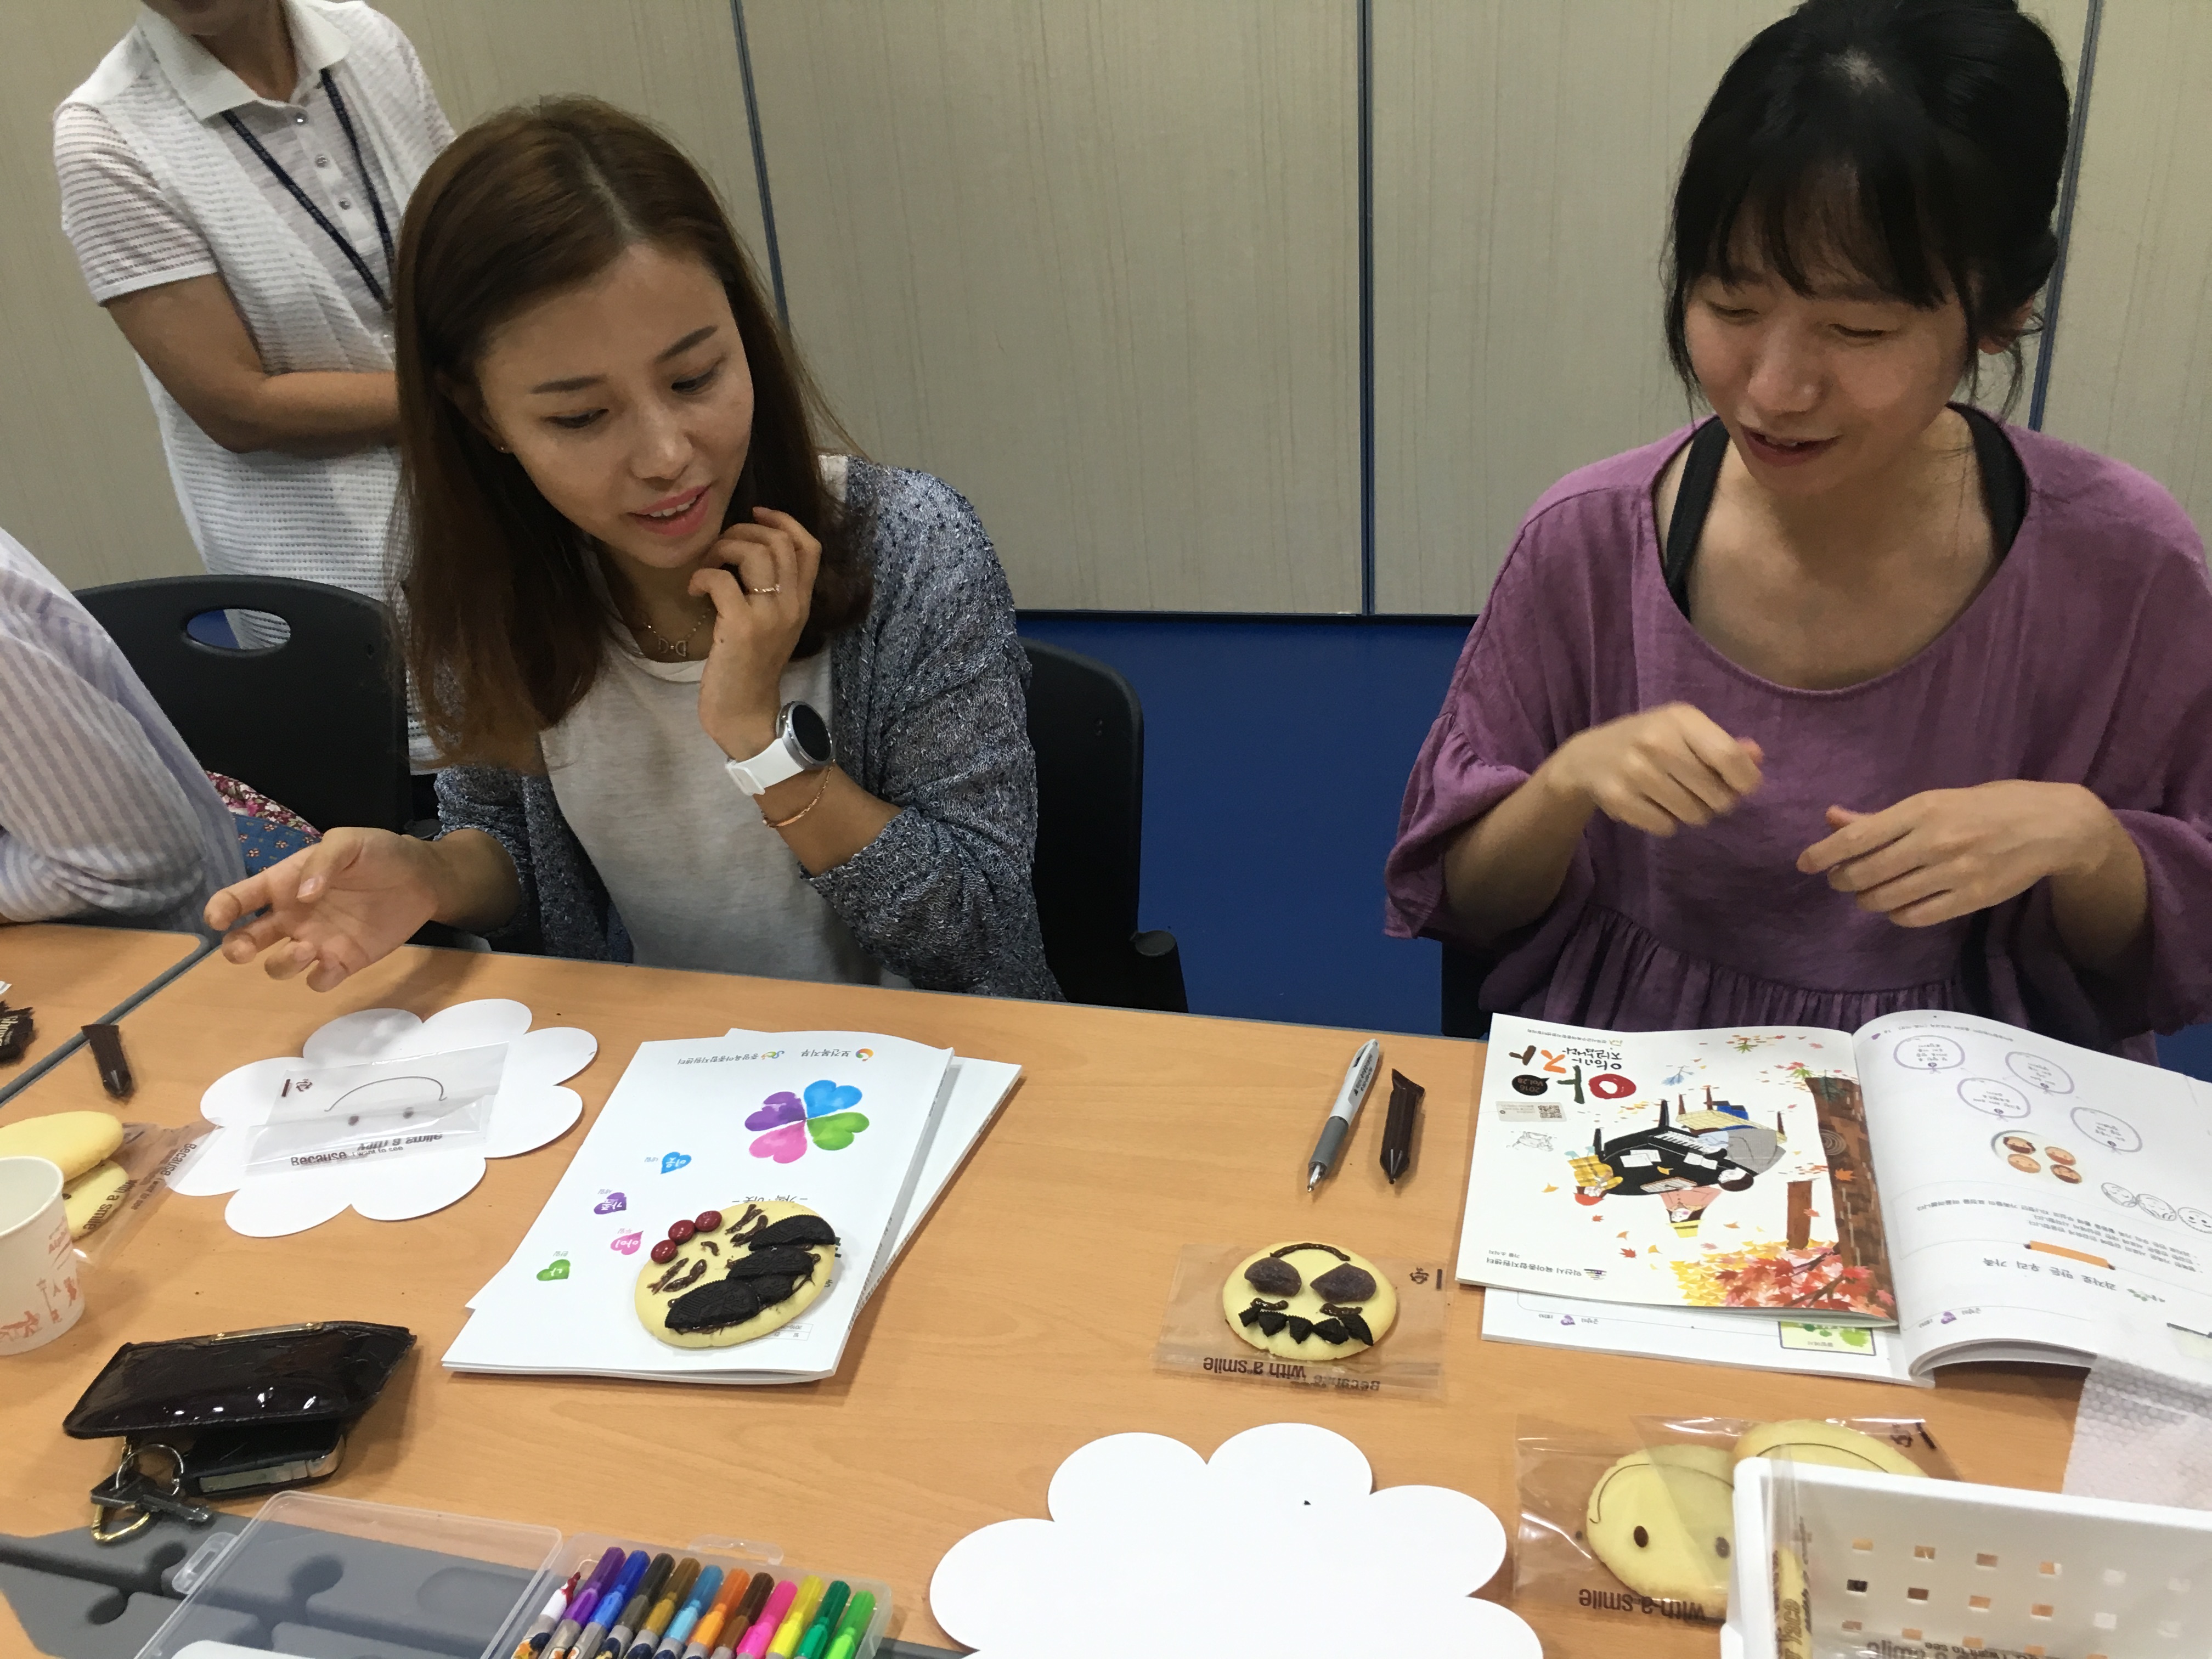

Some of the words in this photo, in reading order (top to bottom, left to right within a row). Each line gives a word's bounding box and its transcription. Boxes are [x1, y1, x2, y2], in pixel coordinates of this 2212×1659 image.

[800, 1048, 851, 1057] 보건복지부
[678, 1053, 759, 1065] 중앙육아종합지원센터
[1571, 1058, 1622, 1070] 아이가
[1517, 1077, 1543, 1086] Vol.28
[1519, 1085, 1540, 1093] 2016
[161, 1143, 197, 1176] Because
[290, 1152, 347, 1166] Because
[665, 1157, 686, 1168] 이웃
[600, 1199, 622, 1211] 가족
[83, 1204, 112, 1230] smile
[615, 1239, 639, 1248] 아이
[1486, 1257, 1553, 1273] 육아종합지원센터
[1983, 1258, 2007, 1267] 가족
[2016, 1261, 2040, 1272] 우리
[550, 1268, 563, 1276] 나
[1556, 1268, 1582, 1277] 익산시
[2049, 1267, 2073, 1279] 만든
[2081, 1275, 2117, 1291] 과자로
[1203, 1357, 1248, 1375] smile
[1253, 1362, 1263, 1375] a
[1269, 1363, 1305, 1379] with
[1578, 1589, 1633, 1612] smile
[1641, 1596, 1653, 1615] a
[1661, 1601, 1706, 1621] with
[1925, 1642, 1948, 1651] see
